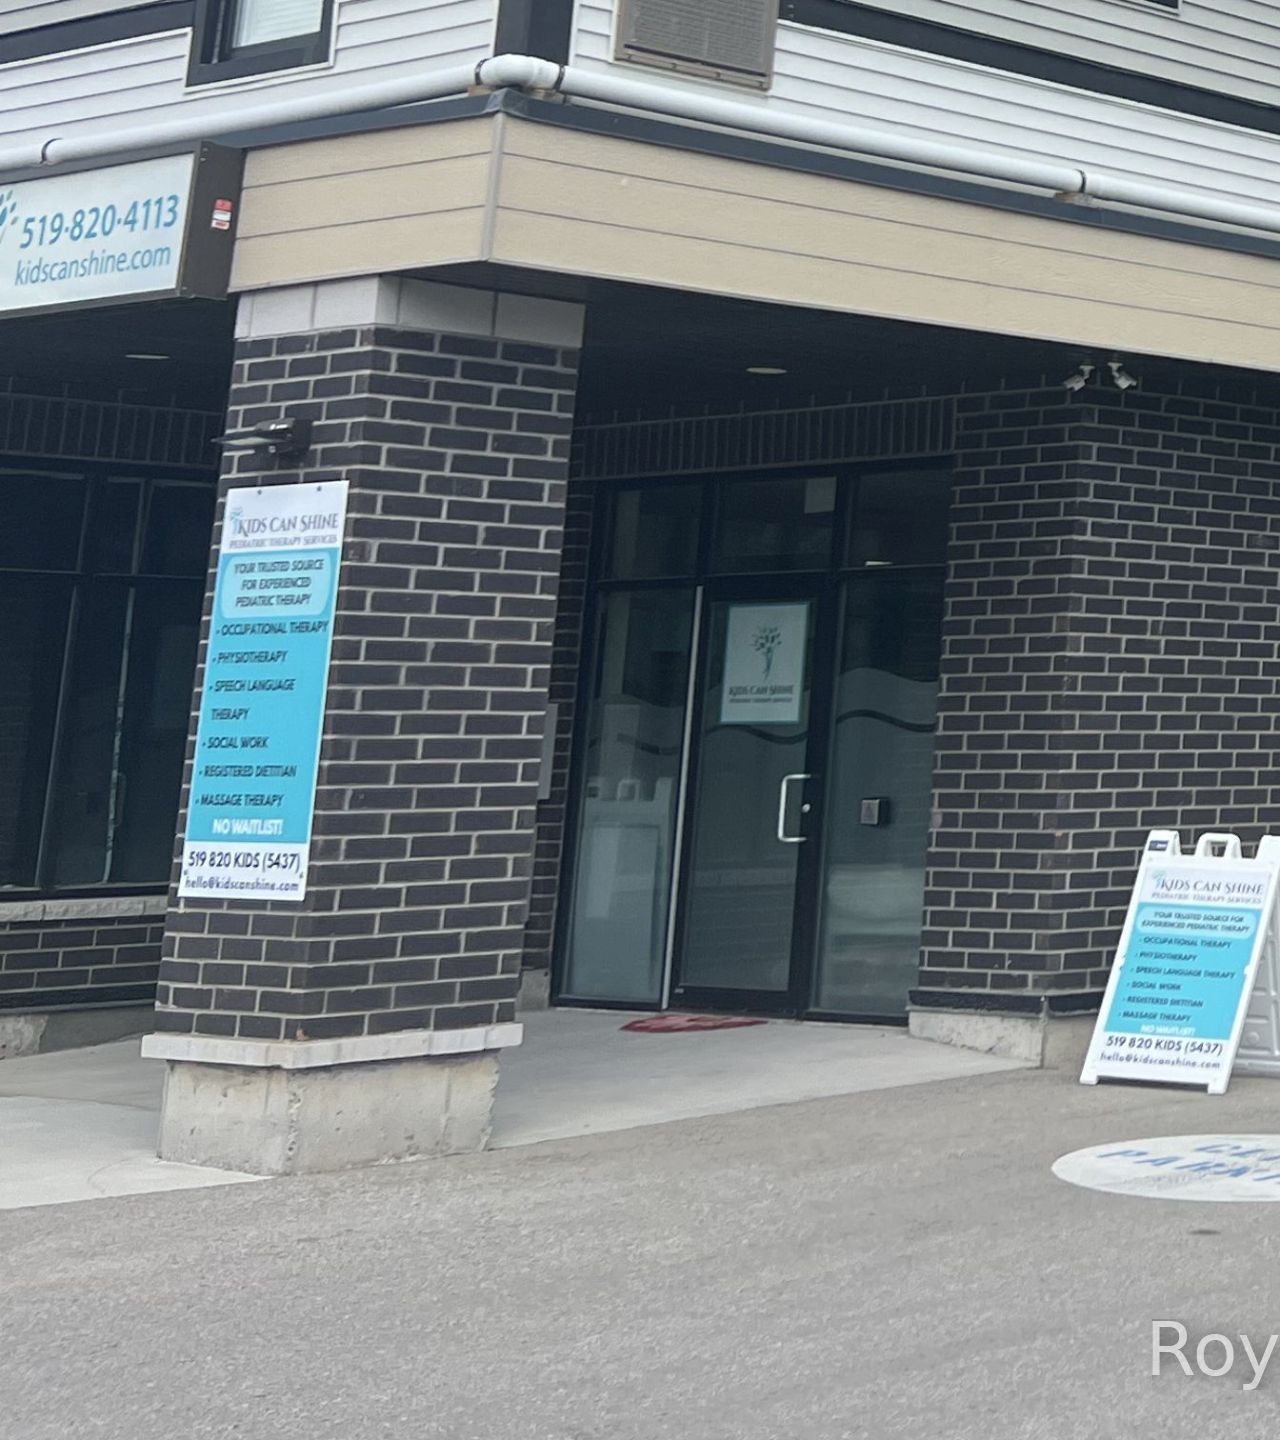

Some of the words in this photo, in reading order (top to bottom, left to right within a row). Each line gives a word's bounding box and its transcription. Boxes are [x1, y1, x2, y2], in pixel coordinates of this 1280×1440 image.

[15, 247, 170, 286] kidscanshine.com
[237, 517, 268, 537] KIDS
[269, 515, 297, 532] CAN
[300, 513, 338, 533] SHINE
[234, 562, 256, 575] YOUR
[257, 560, 290, 574] TRUSTED
[292, 559, 325, 571] SOURCE
[241, 579, 257, 591] FOR
[259, 577, 311, 590] EXPERIENCED
[235, 596, 274, 608] PEDIATRIC
[276, 594, 312, 606] THERAPY
[221, 622, 287, 636] OCCUPATIONAL
[290, 620, 329, 634] THERAPY
[217, 651, 288, 664] PHYSIOTHERAPY
[214, 680, 246, 693] SPEECH
[247, 679, 296, 692] LANGUAGE
[211, 708, 249, 720] THERAPY
[207, 737, 238, 749] SOCIAL
[240, 736, 269, 748] WORK
[204, 765, 253, 777] REGISTERED
[201, 794, 242, 806] MASSAGE
[244, 794, 285, 807] THERAPY
[213, 819, 230, 834] NO
[232, 819, 284, 835] WAITLIST!
[188, 851, 206, 867] 519
[209, 852, 230, 868] 820
[233, 852, 260, 868] KIDS
[262, 853, 300, 874] (5437)
[185, 876, 299, 892] hello@kidscanshine.com
[1161, 879, 1190, 891] KIDS
[1193, 880, 1222, 892] CAN
[1225, 882, 1263, 895] SHINE
[1106, 1035, 1126, 1046] 519
[1128, 1037, 1152, 1049] 820
[1155, 1039, 1182, 1051] KIDS
[1184, 1041, 1223, 1056] (5437)
